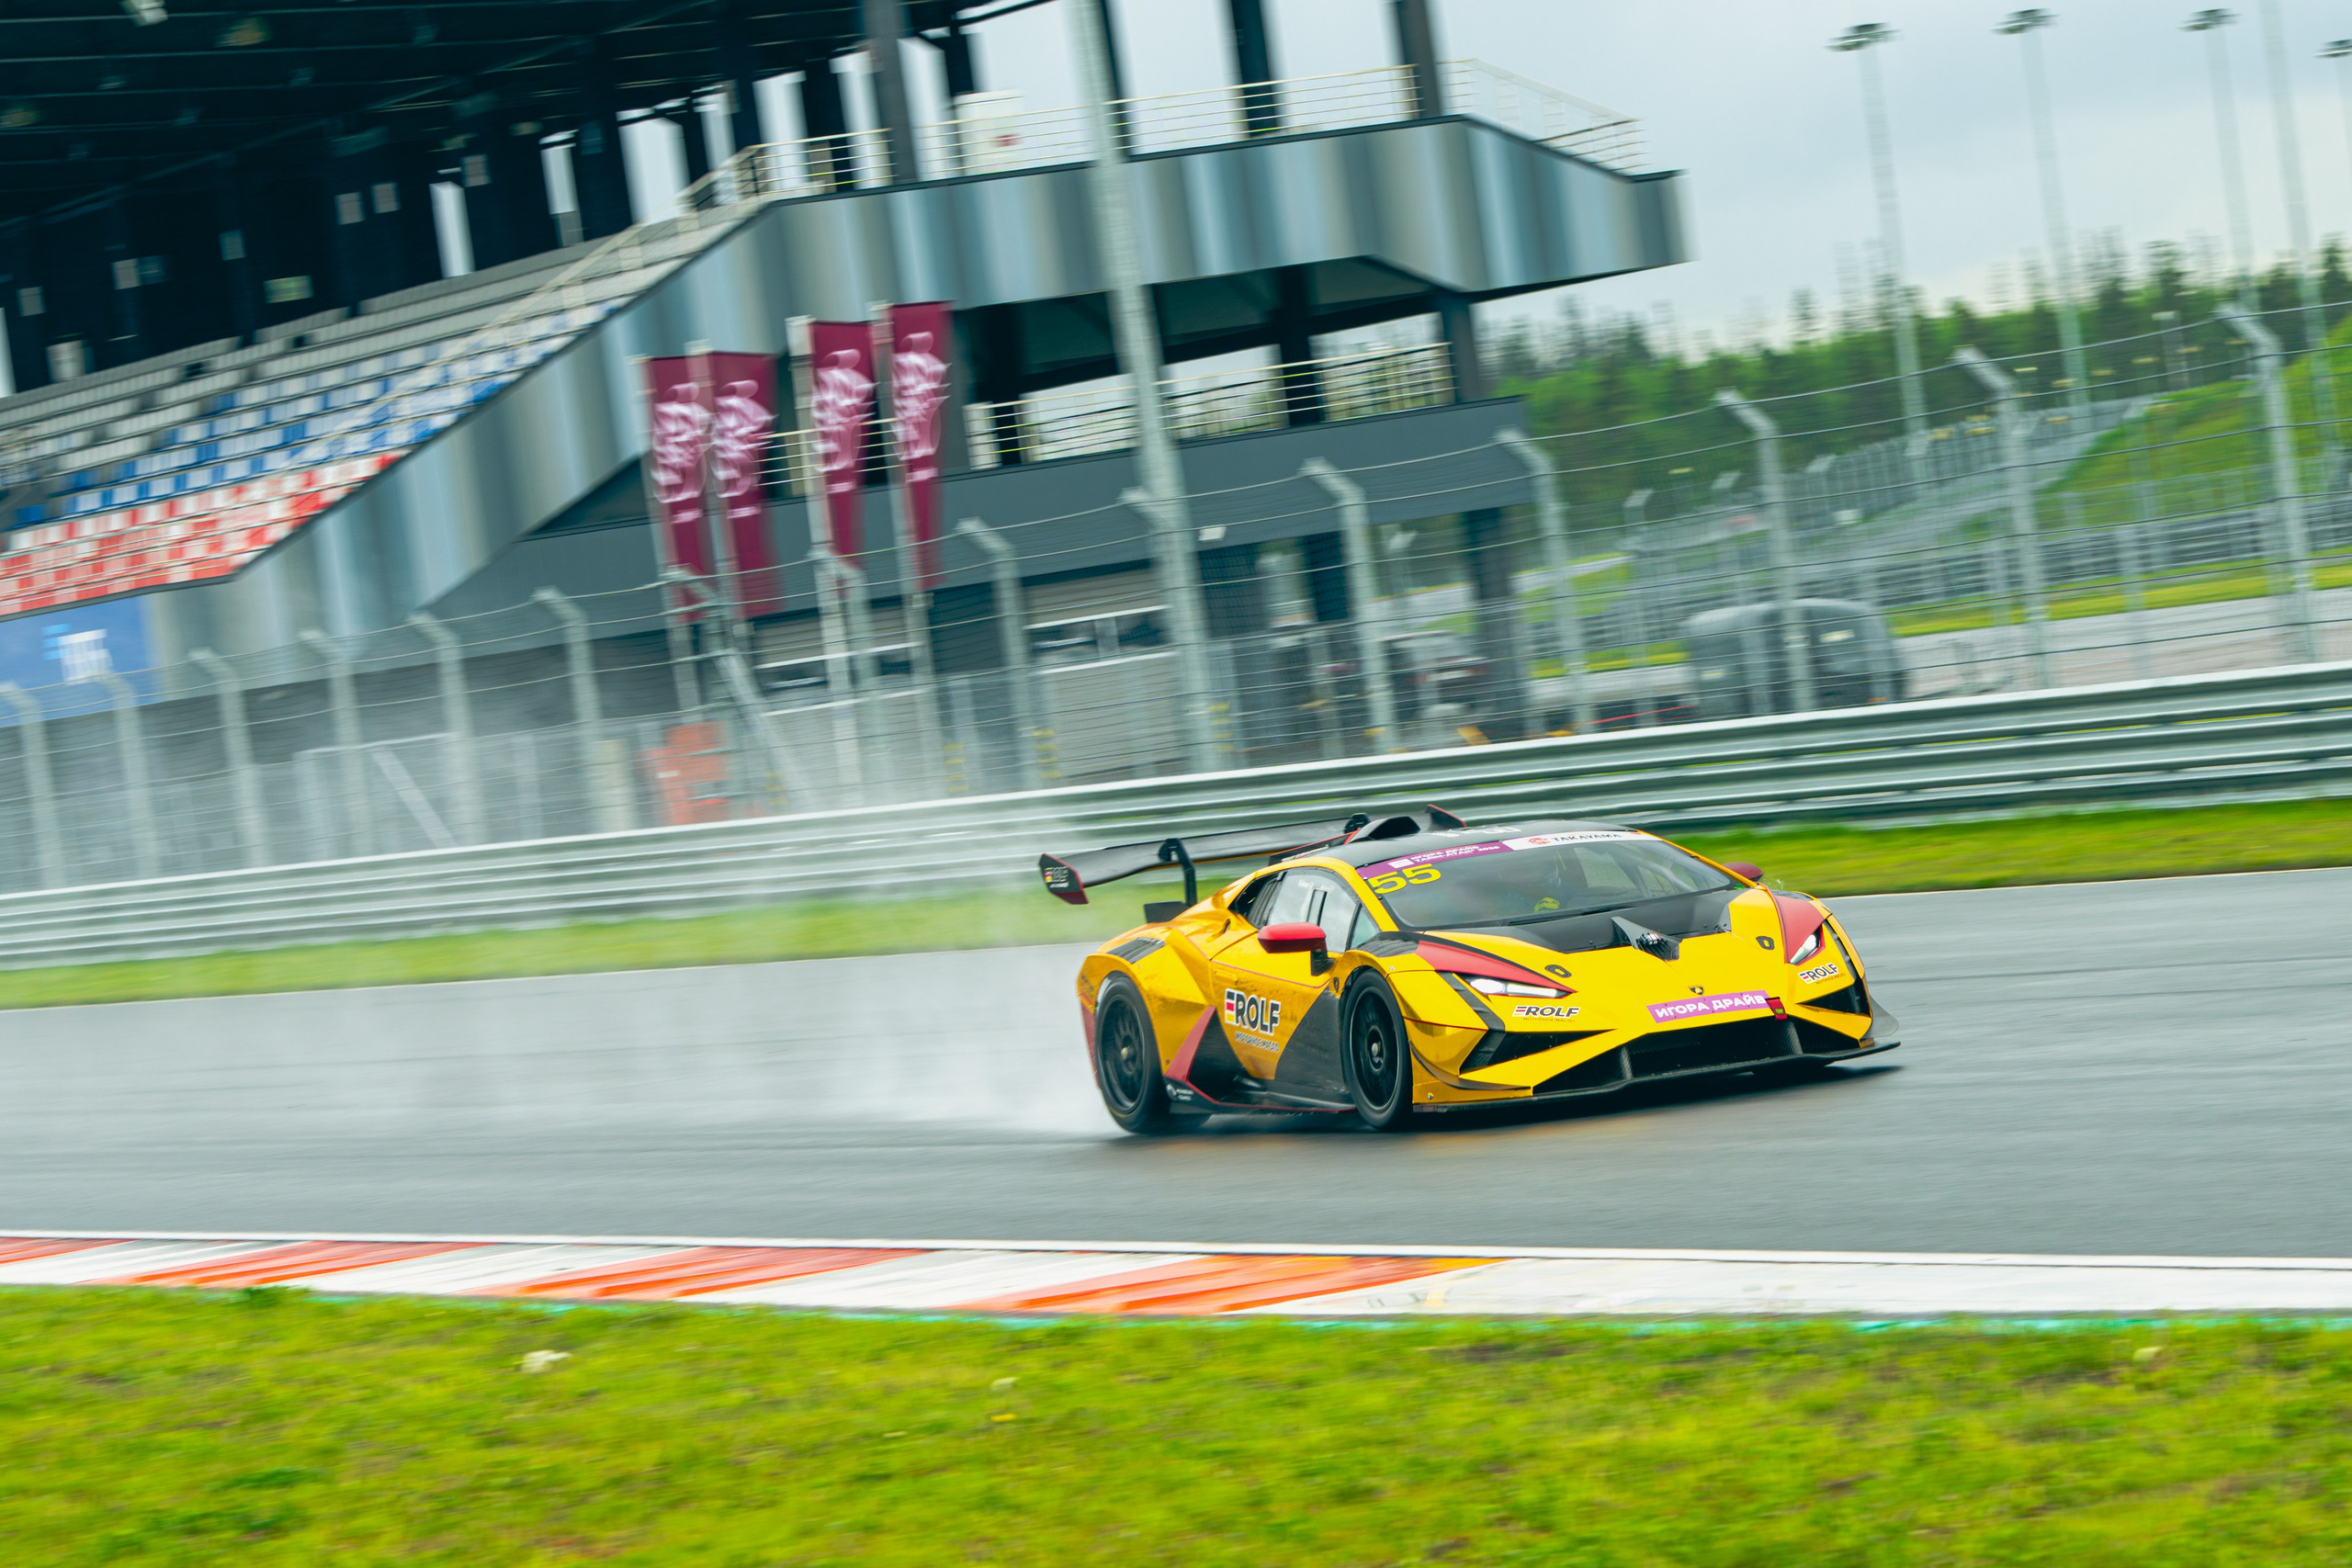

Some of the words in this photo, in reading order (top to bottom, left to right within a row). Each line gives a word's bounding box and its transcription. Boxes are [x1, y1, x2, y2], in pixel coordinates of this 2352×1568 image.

[1551, 833, 1623, 842] TAKAYAMA
[1367, 863, 1442, 894] 55
[1805, 963, 1838, 980] ROLF
[1235, 990, 1281, 1036] ROLF
[1524, 1006, 1580, 1018] ROLF
[1655, 1001, 1710, 1018] ИГОРА
[1711, 995, 1767, 1010] ДРАЙВ
